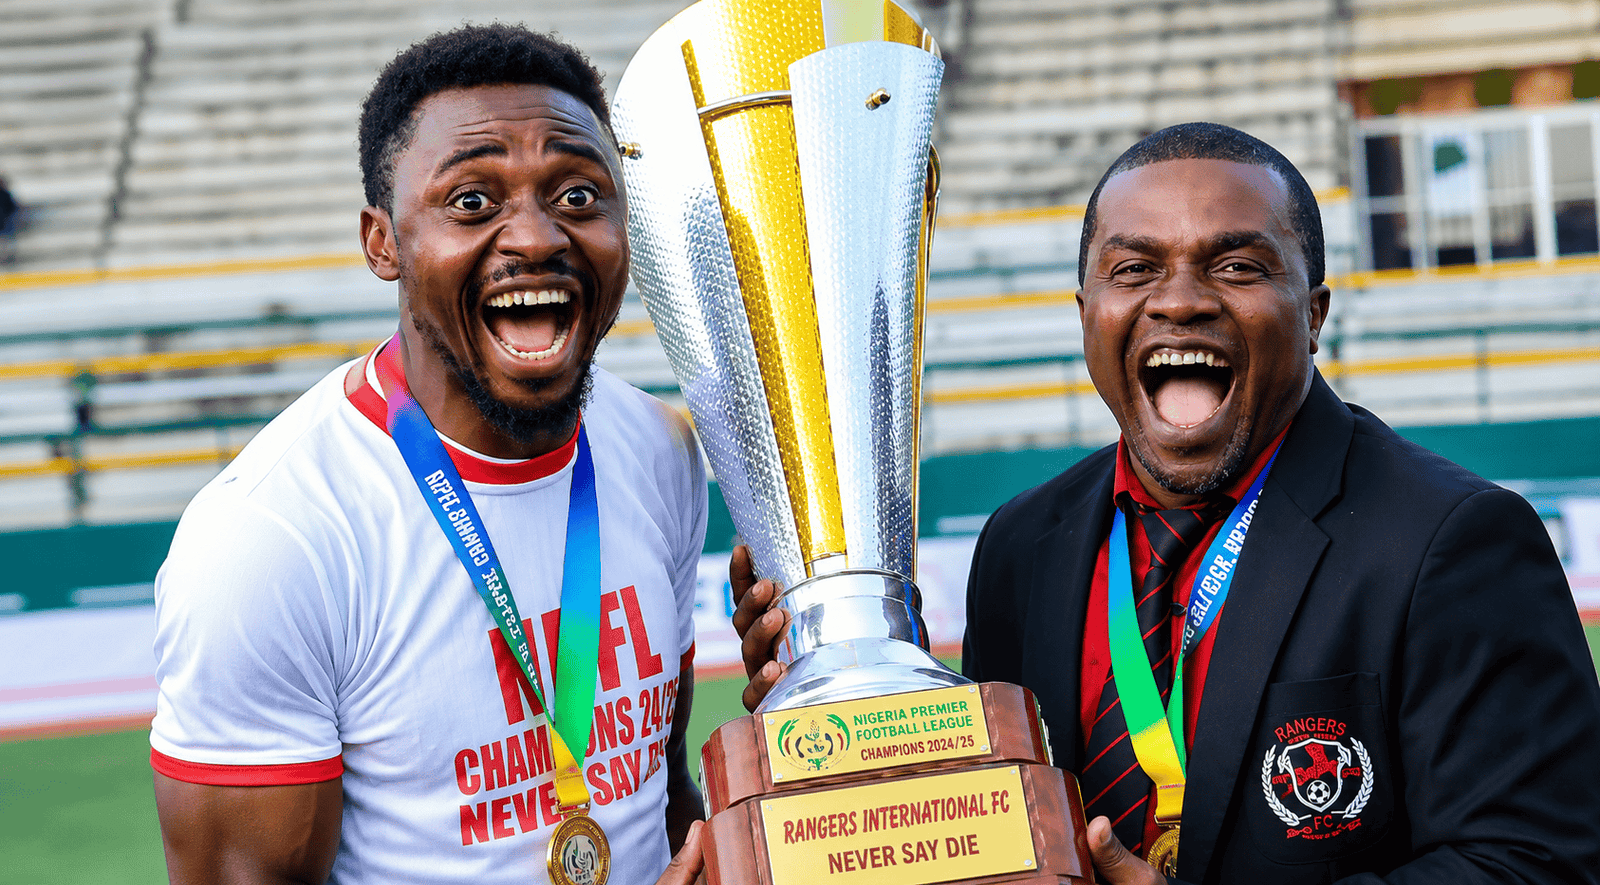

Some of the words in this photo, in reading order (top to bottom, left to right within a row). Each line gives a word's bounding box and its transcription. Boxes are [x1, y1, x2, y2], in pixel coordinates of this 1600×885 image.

[488, 585, 663, 726] NFL
[853, 709, 907, 726] NIGERIA
[910, 700, 969, 718] PREMIER
[856, 725, 920, 742] FOOTBALL
[923, 714, 974, 733] LEAGUE
[1274, 717, 1347, 743] RANGERS
[860, 742, 926, 761] CHAMPIONS
[928, 734, 975, 754] 2024/25
[459, 781, 568, 846] NEVE
[586, 749, 642, 806] SAY
[783, 811, 857, 844] RANGERS
[862, 793, 988, 833] INTERNATIONAL
[991, 789, 1010, 815] FC
[1313, 814, 1334, 830] FC
[828, 844, 897, 874] NEVER
[902, 838, 940, 864] SAY
[945, 833, 980, 857] DIE
